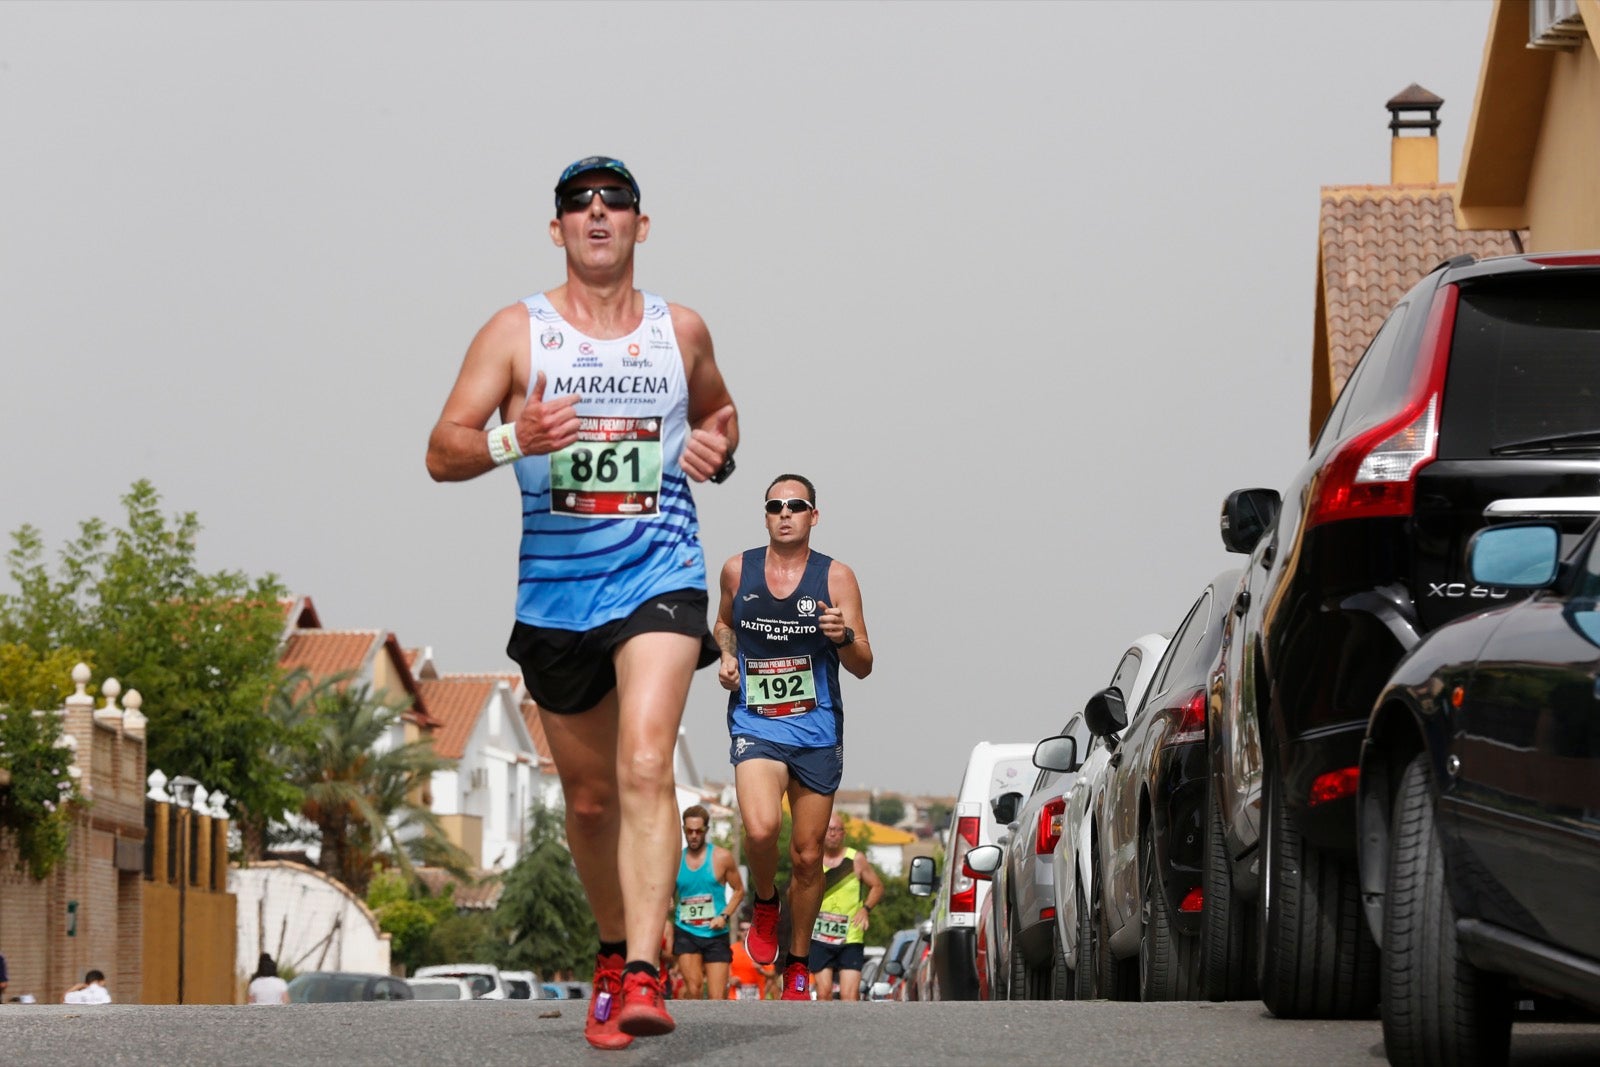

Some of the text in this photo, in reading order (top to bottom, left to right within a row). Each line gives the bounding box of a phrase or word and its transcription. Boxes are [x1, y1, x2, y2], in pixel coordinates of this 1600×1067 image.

[554, 376, 669, 395] MARACENA
[599, 418, 626, 431] PREMIO
[570, 446, 640, 483] 861
[801, 599, 813, 611] 30
[741, 620, 772, 632] PAZITO
[782, 625, 816, 634] PAZITO
[766, 633, 789, 641] Motril
[758, 675, 804, 700] 192
[689, 905, 704, 917] 97
